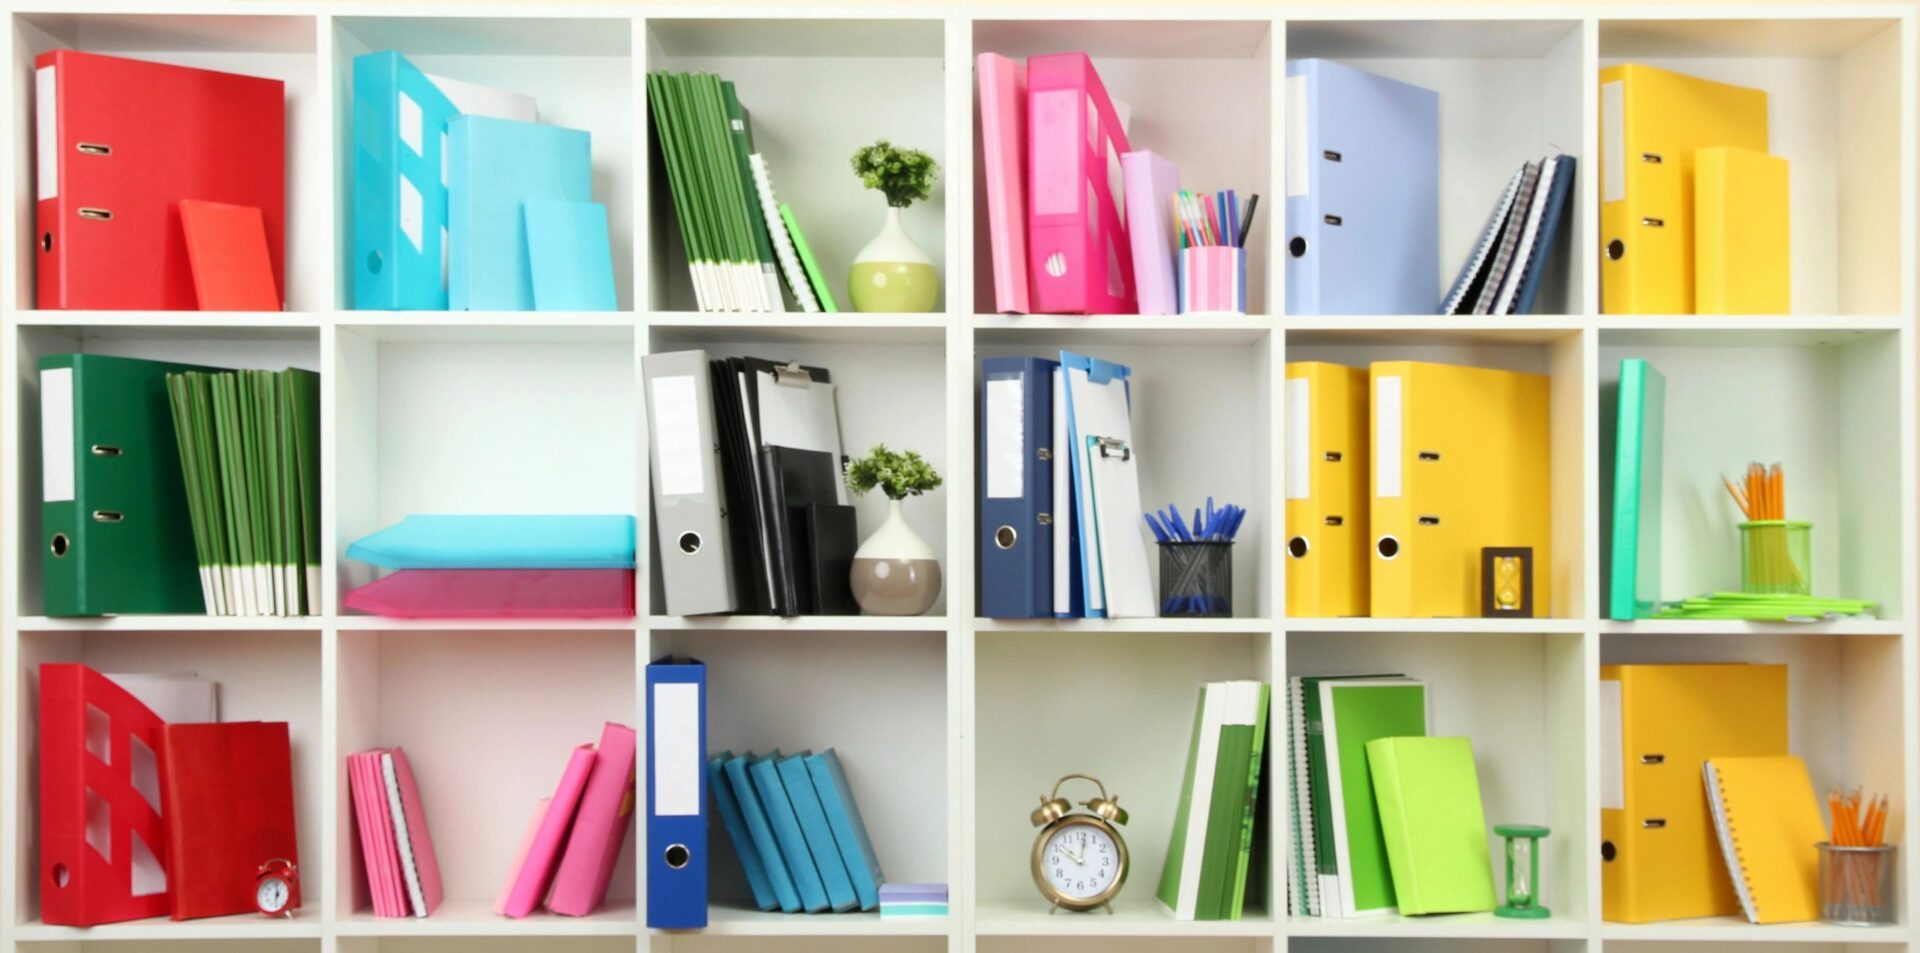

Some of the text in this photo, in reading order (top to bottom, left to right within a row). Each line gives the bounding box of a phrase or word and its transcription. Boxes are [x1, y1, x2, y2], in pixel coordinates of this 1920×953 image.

[1063, 835, 1072, 844] 11
[1076, 832, 1086, 841] 12
[1092, 835, 1096, 844] 1
[1099, 844, 1107, 853] 2
[1052, 856, 1060, 865] 9
[1102, 857, 1109, 866] 3
[1056, 869, 1063, 878] 8
[1098, 869, 1104, 878] 4
[1064, 878, 1072, 887] 7
[1077, 881, 1084, 890] 6
[1089, 878, 1097, 887] 5
